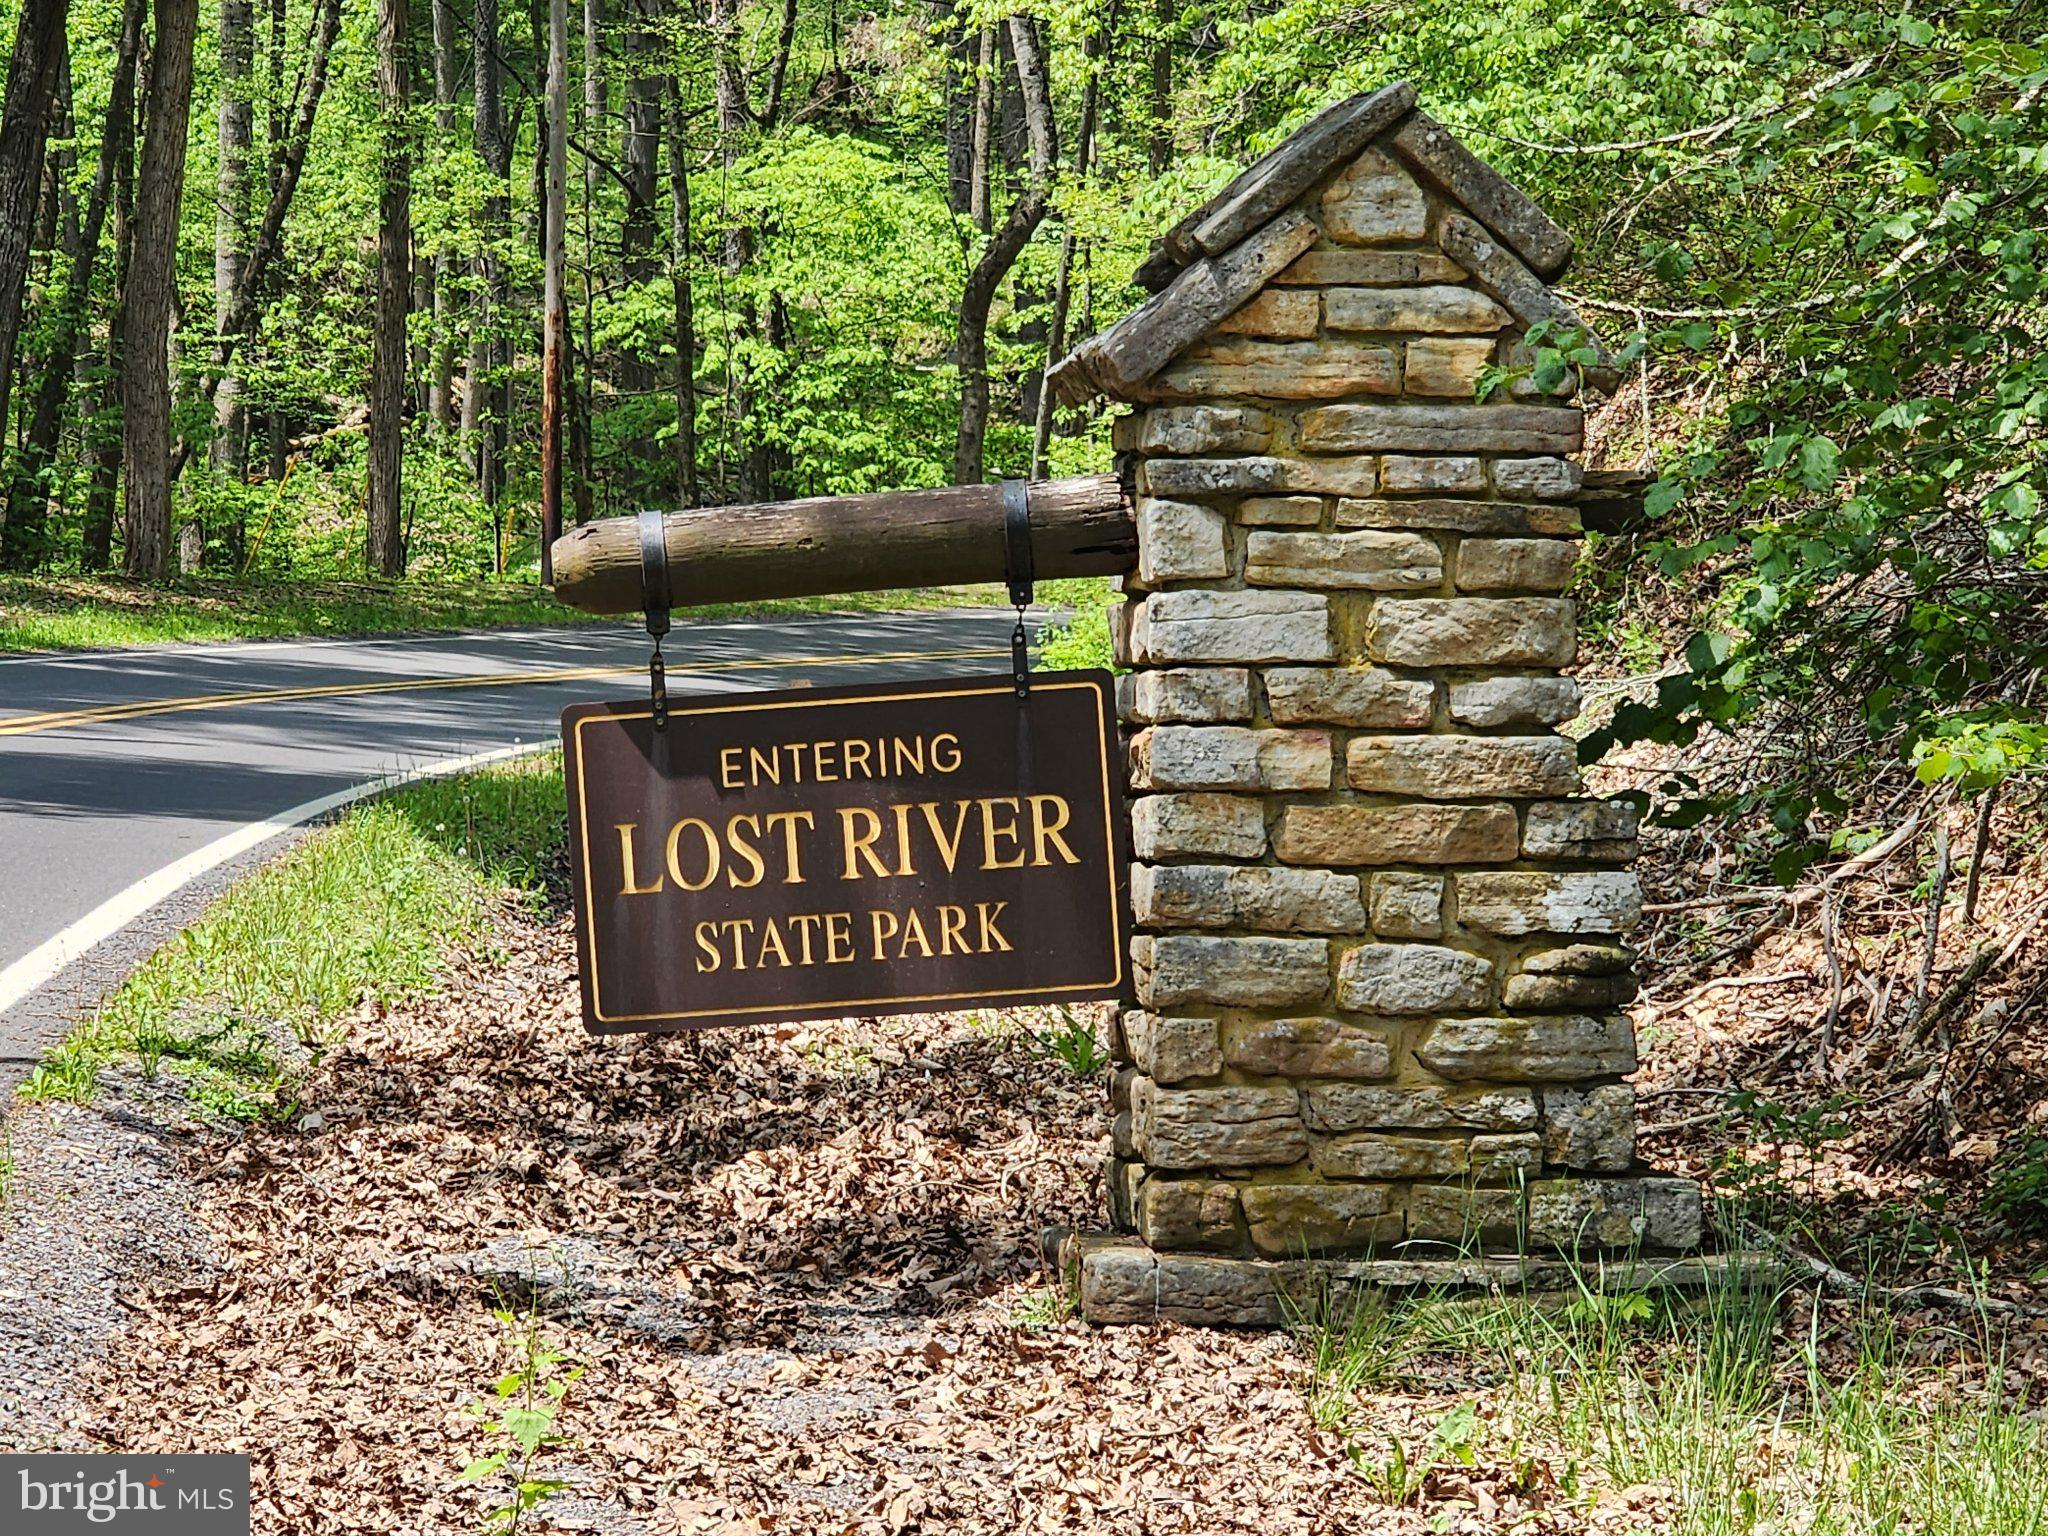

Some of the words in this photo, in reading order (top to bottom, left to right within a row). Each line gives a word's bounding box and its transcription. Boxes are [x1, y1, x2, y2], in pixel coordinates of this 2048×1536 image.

[720, 732, 963, 789] ENTERING
[612, 809, 816, 896] LOST
[834, 793, 1082, 881] RIVER
[694, 911, 857, 974] STATE
[866, 900, 1015, 962] PARK
